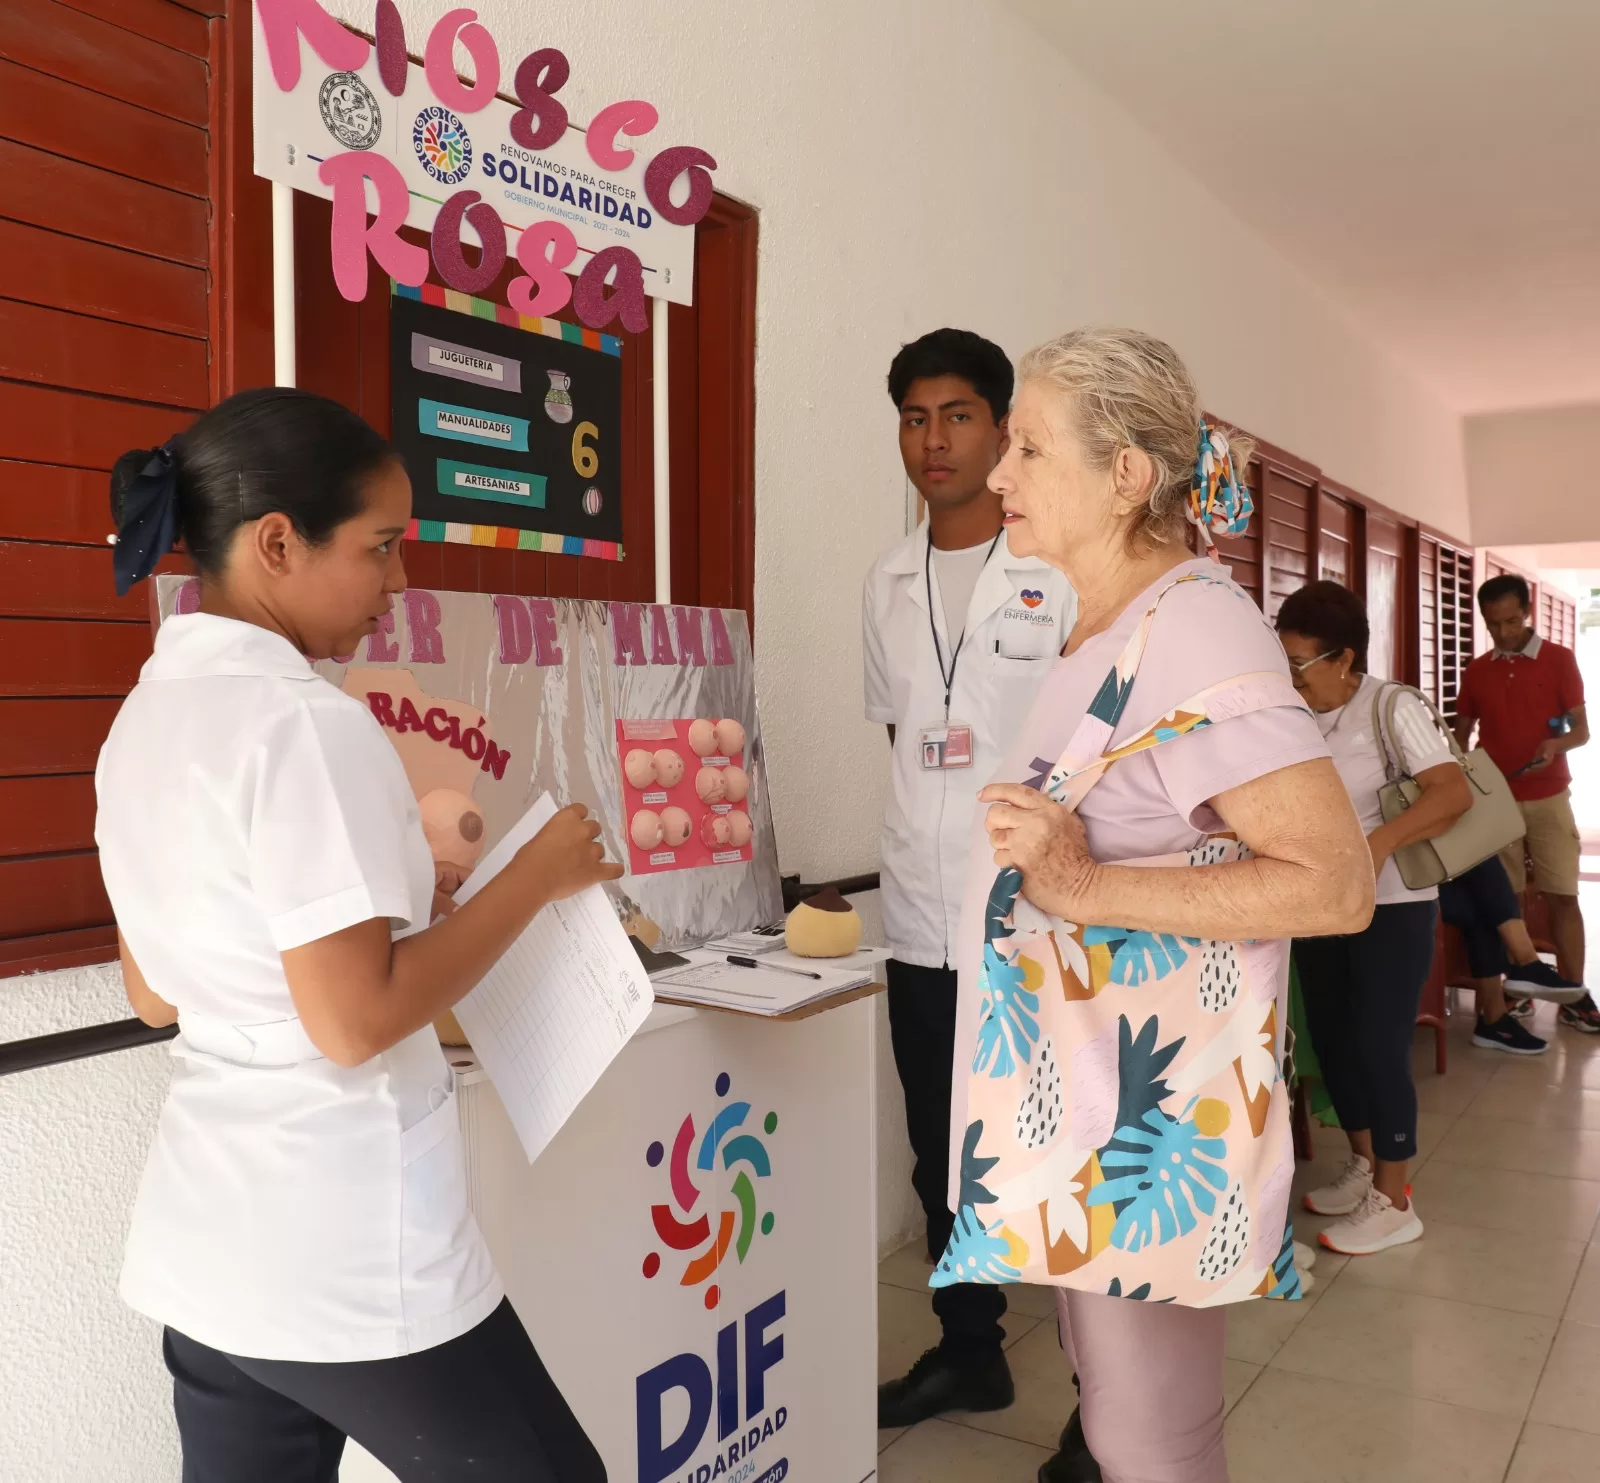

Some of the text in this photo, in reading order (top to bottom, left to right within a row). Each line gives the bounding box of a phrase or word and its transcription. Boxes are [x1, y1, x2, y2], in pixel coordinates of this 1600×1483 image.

[482, 152, 652, 229] SOLIDARIDAD
[500, 143, 636, 200] RENOVAMOS PARA CRECER
[504, 190, 545, 211] GOBIERNO
[547, 204, 588, 225] MUNICIPAL
[593, 220, 608, 232] 2021
[439, 349, 493, 372] JUGUETERIA
[438, 411, 511, 434] MANUALIDADES
[571, 420, 599, 479] 6
[464, 474, 520, 492] ARTESANIAS
[494, 594, 564, 666] DE
[609, 601, 736, 667] MAMA
[1004, 610, 1054, 623] ENFERMERÍA
[636, 1289, 786, 1483] DIF
